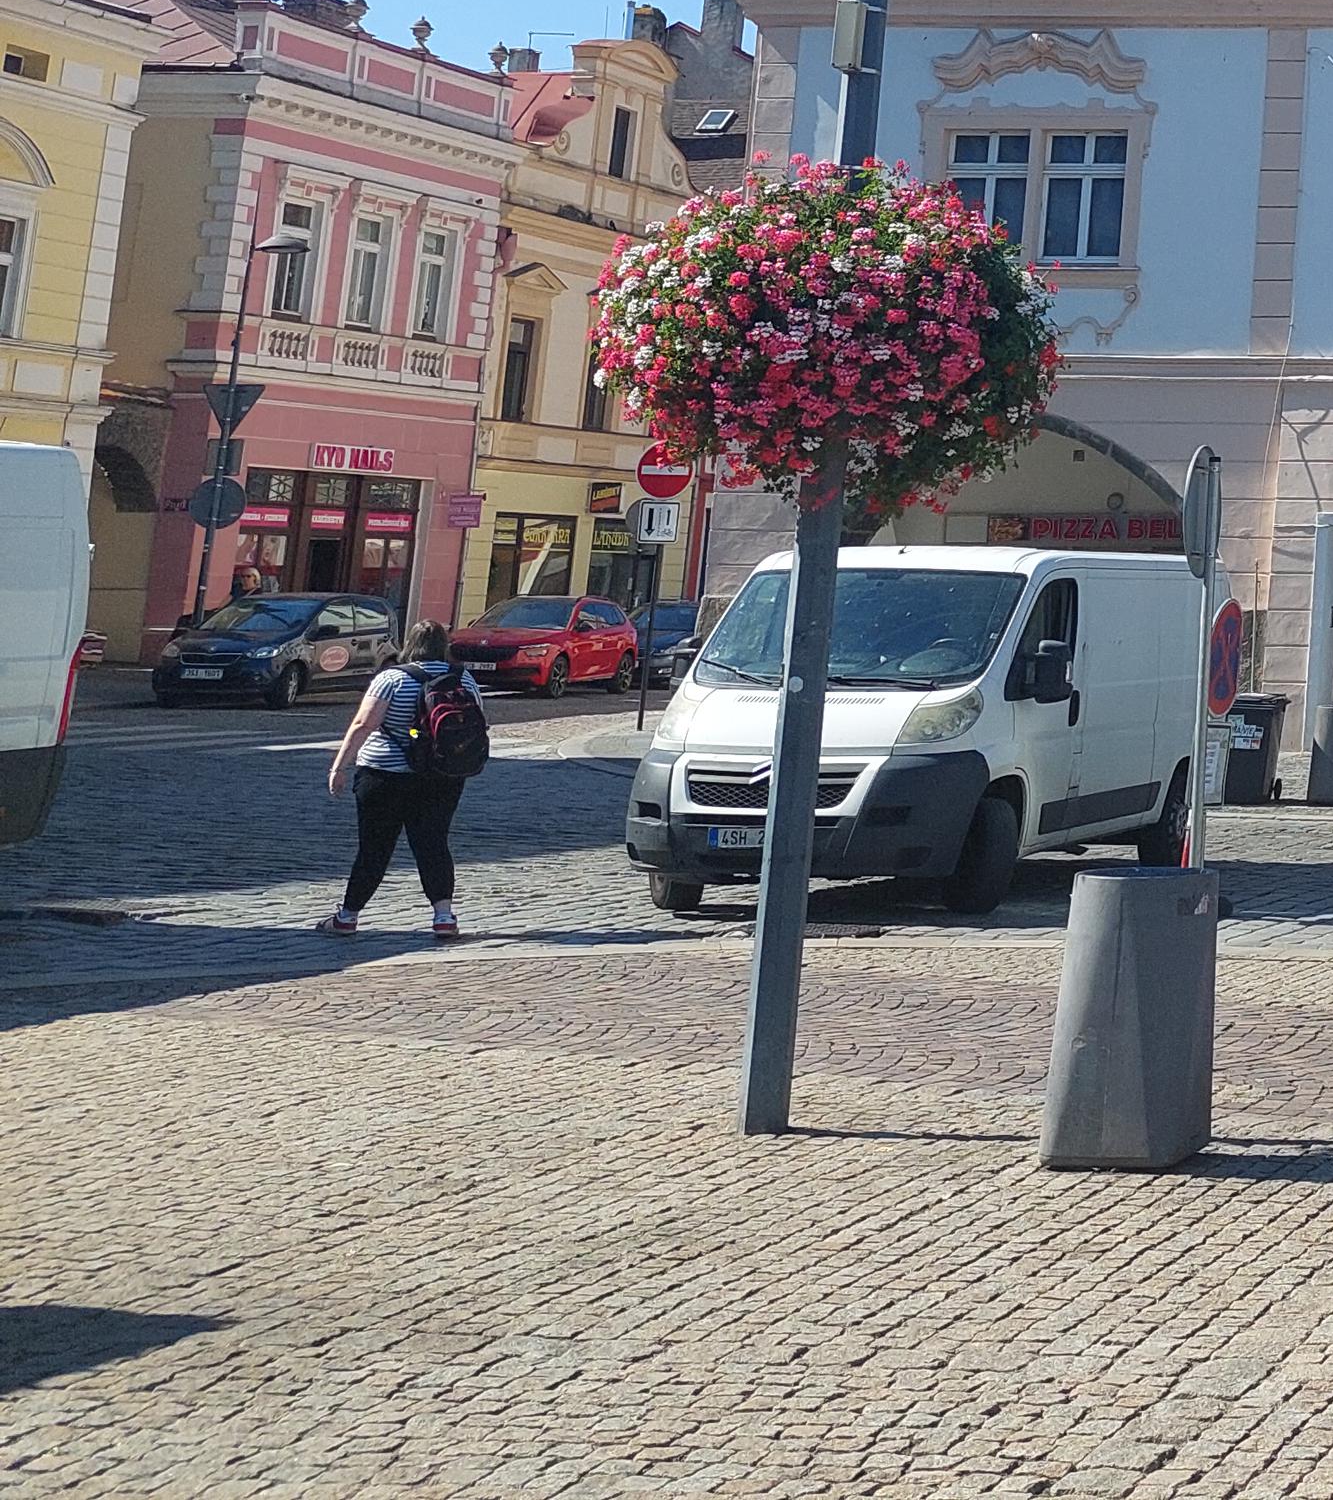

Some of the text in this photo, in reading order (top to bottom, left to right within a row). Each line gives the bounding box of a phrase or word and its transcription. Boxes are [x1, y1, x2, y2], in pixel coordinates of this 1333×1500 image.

[314, 445, 395, 472] KYO NAILS
[1032, 518, 1184, 541] PIZZA BEL
[721, 831, 748, 845] 4SH
